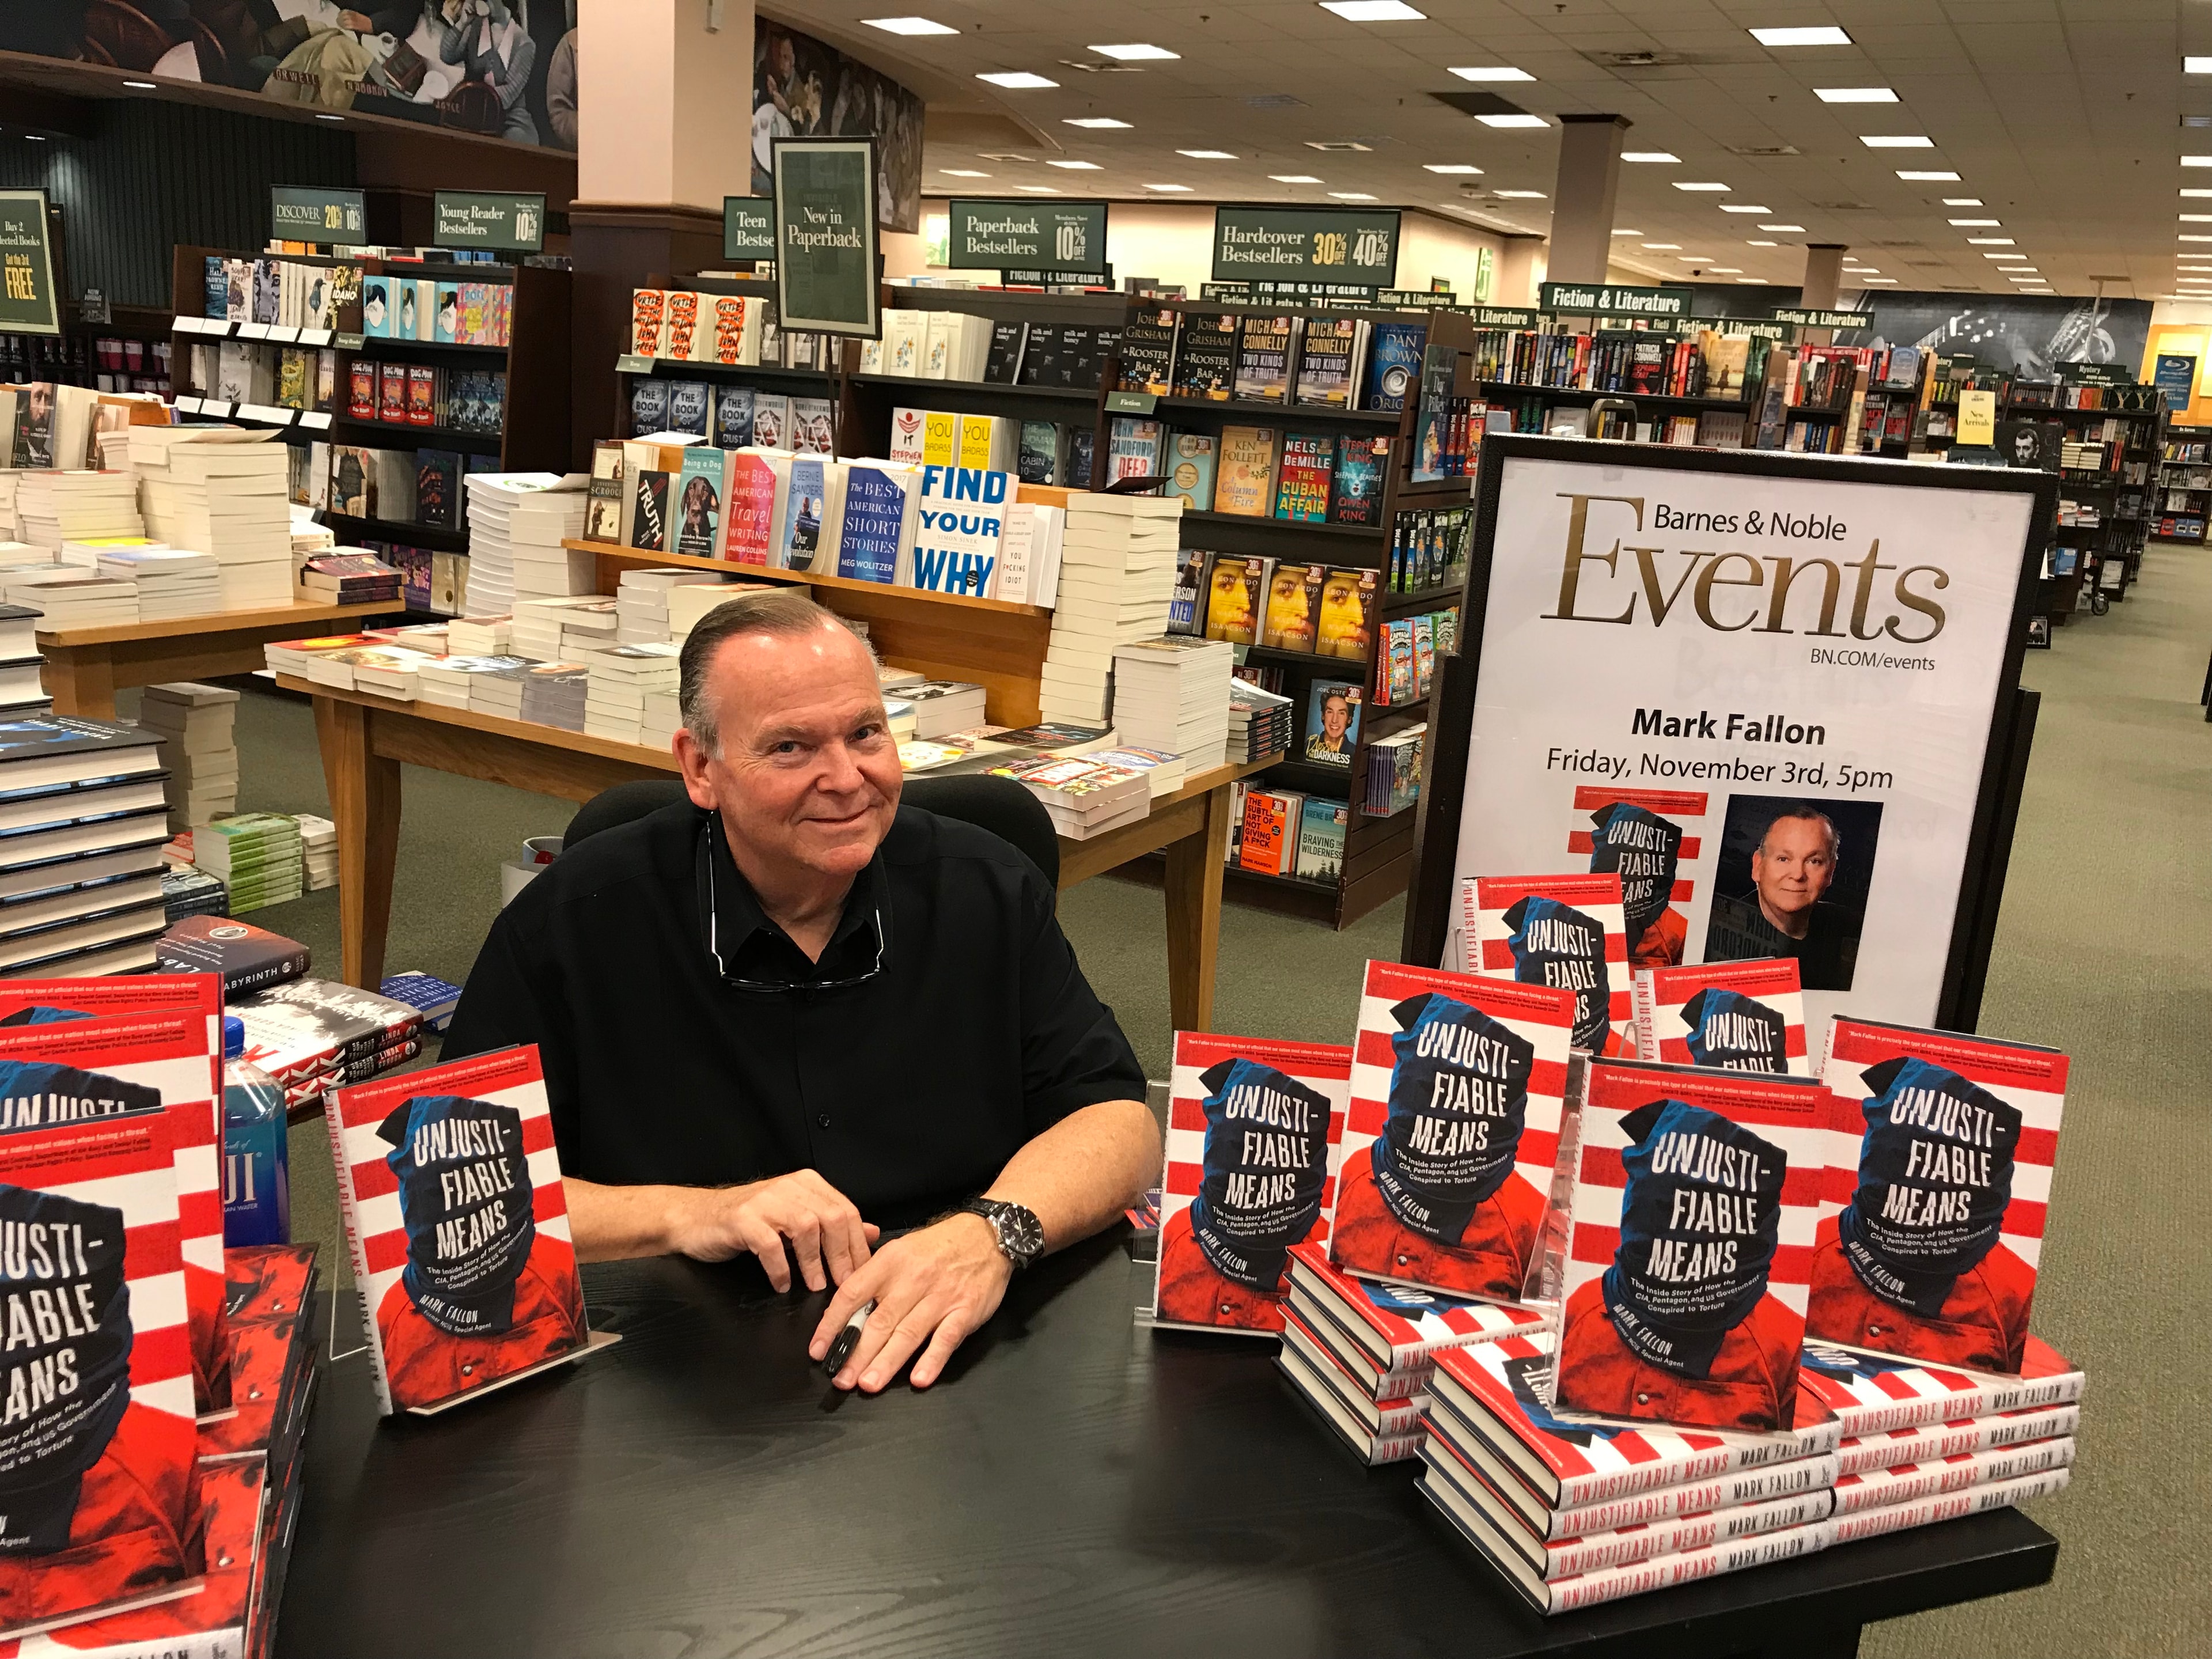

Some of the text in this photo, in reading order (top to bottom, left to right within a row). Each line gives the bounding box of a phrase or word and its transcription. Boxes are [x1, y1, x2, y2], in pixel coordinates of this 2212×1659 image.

[276, 204, 320, 220] DISCOVER
[440, 204, 505, 221] Young Reader
[737, 211, 767, 228] Teen
[803, 206, 842, 225] New in
[440, 221, 487, 236] Bestsellers
[967, 215, 1039, 238] Paperback
[20, 235, 40, 246] Books
[737, 230, 774, 247] Bestse
[787, 225, 862, 253] Paperback
[1222, 226, 1305, 245] Hardcover
[967, 238, 1037, 255] Bestsellers
[1056, 226, 1085, 261] 10%
[1312, 233, 1347, 265] 30%
[1353, 234, 1388, 266] 40%
[1221, 245, 1303, 264] Bestsellers
[5, 267, 36, 300] FREE
[332, 289, 357, 301] IDAHO
[634, 292, 664, 306] TURTLES
[1377, 291, 1450, 305] Fiction & Literature
[1552, 288, 1680, 312] Fiction & Literature
[1480, 309, 1527, 325] Literature
[1776, 309, 1867, 328] Fiction & Literature
[1126, 326, 1171, 341] GRISHAM
[1385, 334, 1417, 348] DAN
[634, 340, 660, 354] GREEN
[1243, 336, 1287, 351] CONNELLY
[1635, 343, 1660, 353] PATRICIA
[1129, 346, 1168, 359] ROOSTER
[1376, 349, 1422, 363] BROWN
[1634, 353, 1662, 362] CORNWELL
[1135, 361, 1152, 372] BAR
[1243, 353, 1283, 368] TWO KINDS
[1244, 368, 1278, 380] OF TRUTH
[2079, 365, 2101, 374] Mystery
[727, 398, 741, 408] THE
[1120, 399, 1141, 407] Fiction
[722, 410, 745, 421] BOOK
[1970, 410, 1984, 419] New
[1963, 418, 1990, 427] Arrivals
[926, 423, 952, 438] YOU
[722, 434, 744, 444] DUST
[903, 434, 914, 446] IT
[1236, 440, 1256, 451] KEN
[891, 449, 922, 460] STEPHEN
[925, 443, 952, 453] BADASS
[1286, 441, 1316, 453] NELS
[1021, 456, 1045, 467] CABIN
[1223, 449, 1267, 464] FOLLETT
[684, 459, 700, 468] Being
[709, 460, 722, 471] Dog
[737, 469, 776, 484] THE BEST
[797, 470, 820, 482] BERNIE
[890, 474, 907, 483] 2017
[1297, 471, 1315, 480] THE
[591, 487, 623, 497] SCROOGE
[791, 484, 823, 496] SANDERS
[850, 482, 904, 499] The BEST
[922, 464, 1007, 505] FIND
[1221, 483, 1258, 495] Column
[1282, 481, 1328, 498] CUBAN
[733, 487, 773, 499] AMERICAN
[847, 501, 900, 515] AMERICAN
[1233, 495, 1255, 507] Fire
[1279, 497, 1325, 514] AFFAIR
[1338, 497, 1369, 509] OWEN
[638, 479, 662, 543] TRUTH
[732, 502, 770, 524] Travel
[1339, 510, 1366, 521] KING
[845, 517, 900, 536] SHORT
[919, 510, 1001, 537] YOUR
[1654, 504, 1847, 541] Barnes & Noble
[729, 529, 768, 542] WRITING
[795, 533, 808, 546] Our
[937, 535, 957, 543] SIMON
[726, 544, 767, 555] LAUREN COLLINS
[785, 543, 814, 559] Revolution
[843, 537, 896, 554] STORIES
[1010, 551, 1022, 560] YOU
[841, 558, 893, 572] MEG WOLITZER
[914, 546, 995, 599] WHY
[1540, 492, 1950, 644] Events
[1005, 577, 1022, 585] IDIOT
[1321, 637, 1364, 649] ISAACSON
[1810, 648, 1936, 671] BN.COM/events
[1631, 708, 1825, 745] Mark Fallon
[1314, 749, 1350, 764] DARKNESS
[1547, 748, 1893, 790] Friday, November 3rd, 5pm
[1248, 797, 1262, 806] THE
[1247, 805, 1275, 818] SUBTLE
[1247, 813, 1274, 825] ART OF
[1245, 820, 1261, 830] NOT
[1245, 828, 1271, 840] GIVING
[1302, 834, 1335, 849] BRAVING
[1301, 844, 1344, 859] WILDERNESS
[224, 967, 278, 991] ABYRINTH
[441, 1157, 516, 1211] FIABLE
[1669, 1188, 1758, 1235] FIABLE
[436, 1199, 507, 1260] MEANS
[1646, 1237, 1737, 1283] MEANS
[1631, 1277, 1645, 1290] The
[1646, 1285, 1669, 1297] Inside
[1672, 1287, 1692, 1297] Story
[1694, 1286, 1703, 1294] of
[1705, 1283, 1722, 1292] How
[1635, 1292, 1650, 1303] CIA,
[1652, 1296, 1690, 1304] Pentagon,
[1691, 1295, 1704, 1303] and
[1716, 1274, 1760, 1298] Government
[1647, 1304, 1685, 1315] Conspired
[1699, 1301, 1725, 1313] Torture
[1613, 1303, 1673, 1356] MARK FALLON
[1613, 1319, 1684, 1368] Former NCIS Special Agent
[1563, 1469, 1810, 1535] UNJUSTIFIABLE MEANS MARK FALLON
